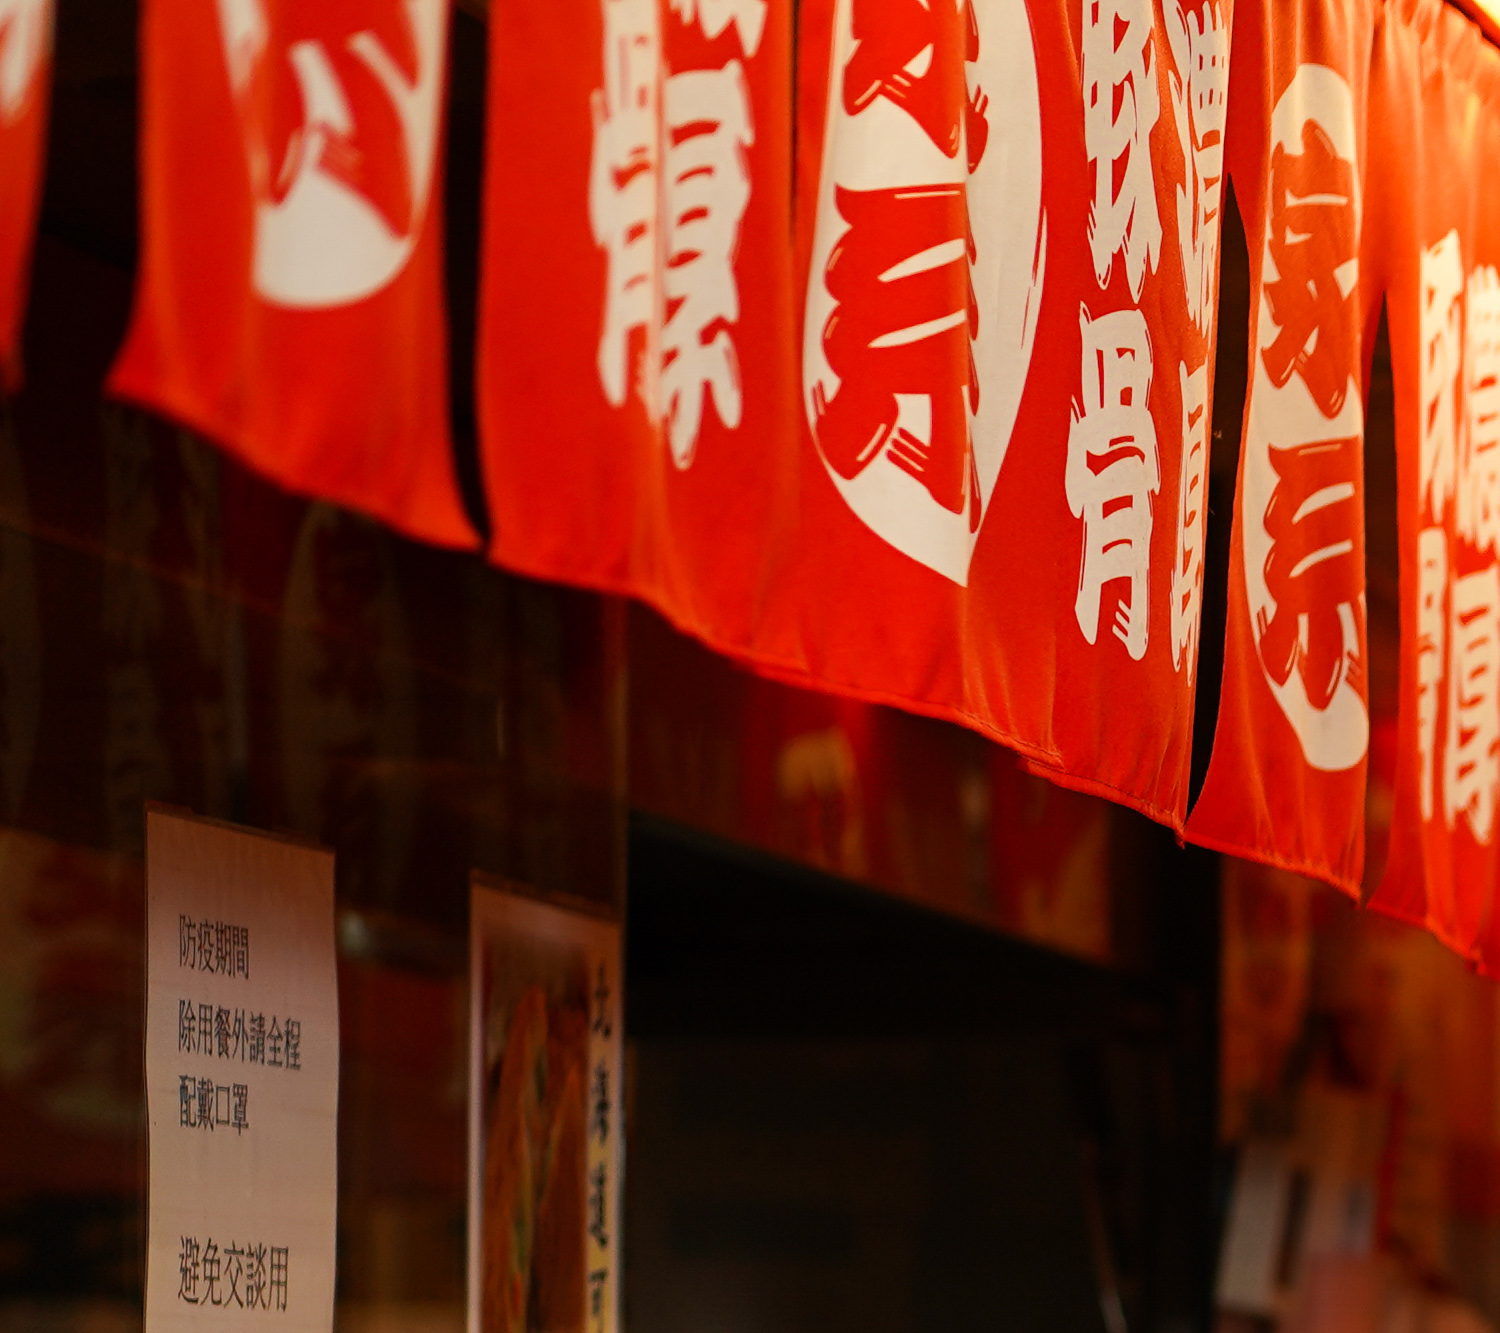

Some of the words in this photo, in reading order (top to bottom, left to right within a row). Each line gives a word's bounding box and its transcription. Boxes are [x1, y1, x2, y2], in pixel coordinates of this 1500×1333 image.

[178, 914, 250, 979] 防疫期間
[178, 999, 301, 1071] 除用餐外請全程
[178, 1074, 250, 1136] 配戴口罩
[178, 1235, 290, 1312] 避免交談用
